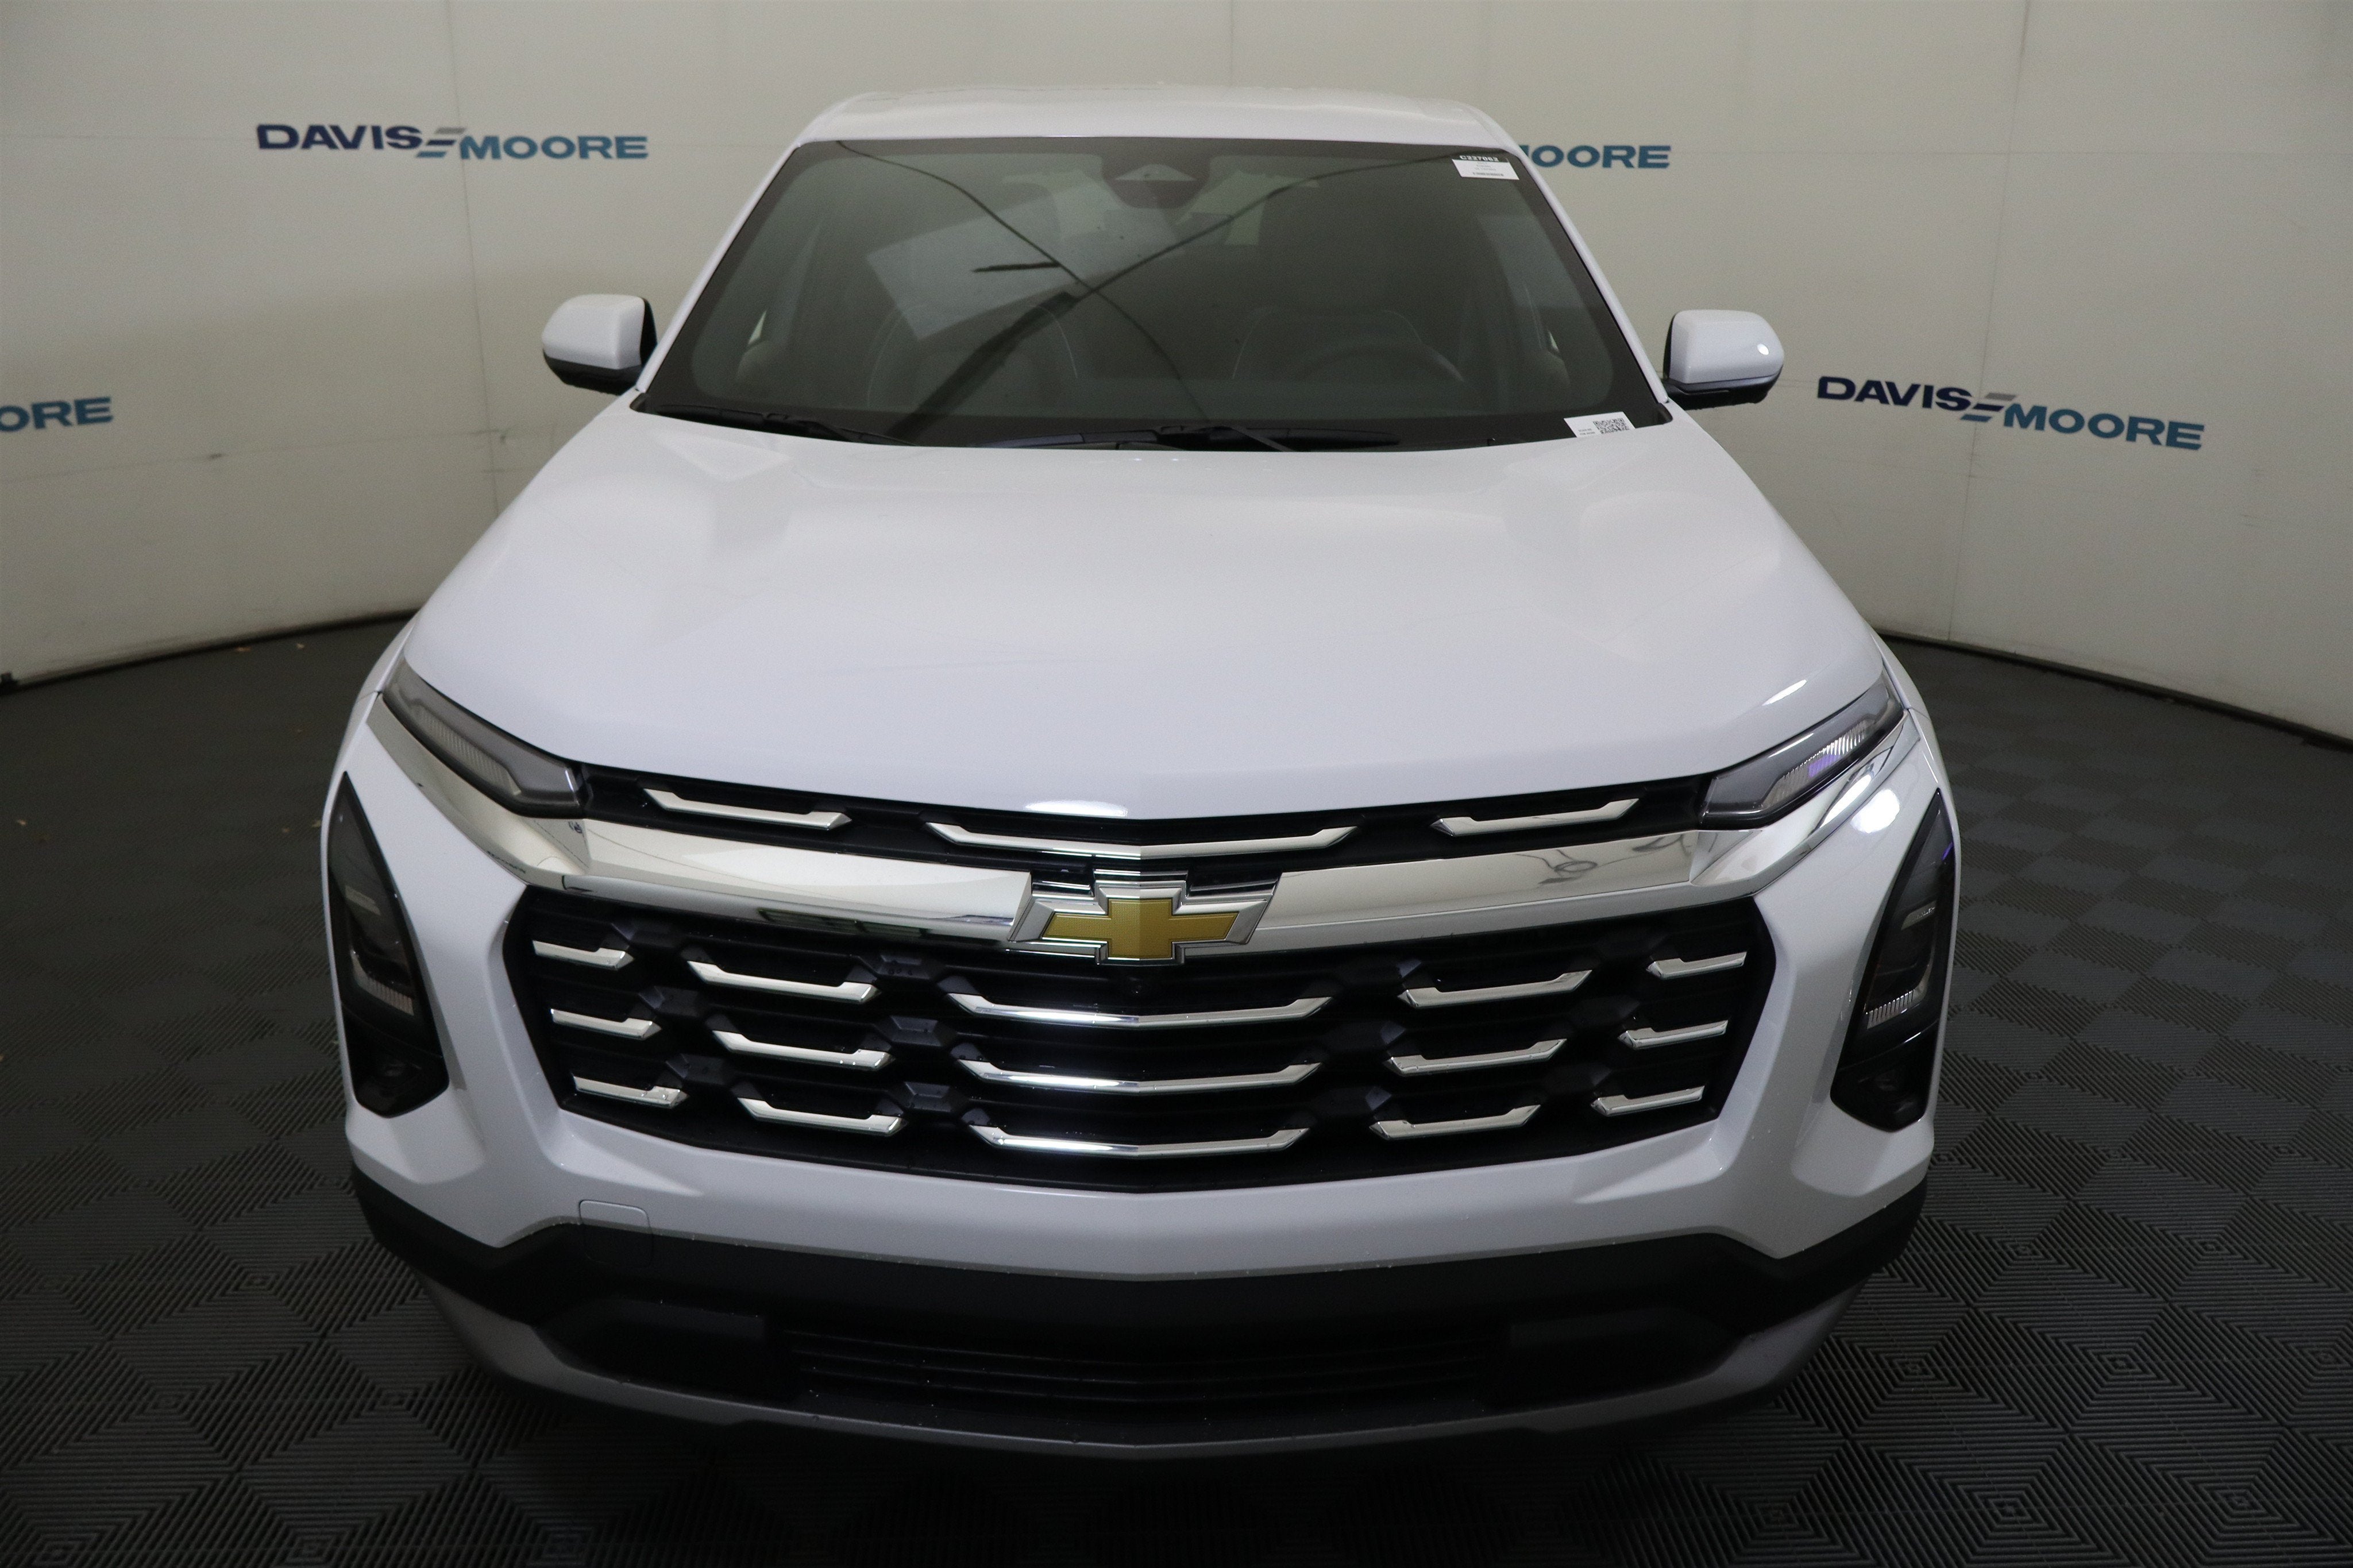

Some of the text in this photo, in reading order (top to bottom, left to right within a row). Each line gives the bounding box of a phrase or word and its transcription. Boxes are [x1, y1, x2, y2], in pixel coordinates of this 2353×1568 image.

[256, 123, 649, 160] DAVIS MOORE
[1519, 145, 1671, 169] OORE
[1816, 375, 2205, 451] DAVIS MOORE
